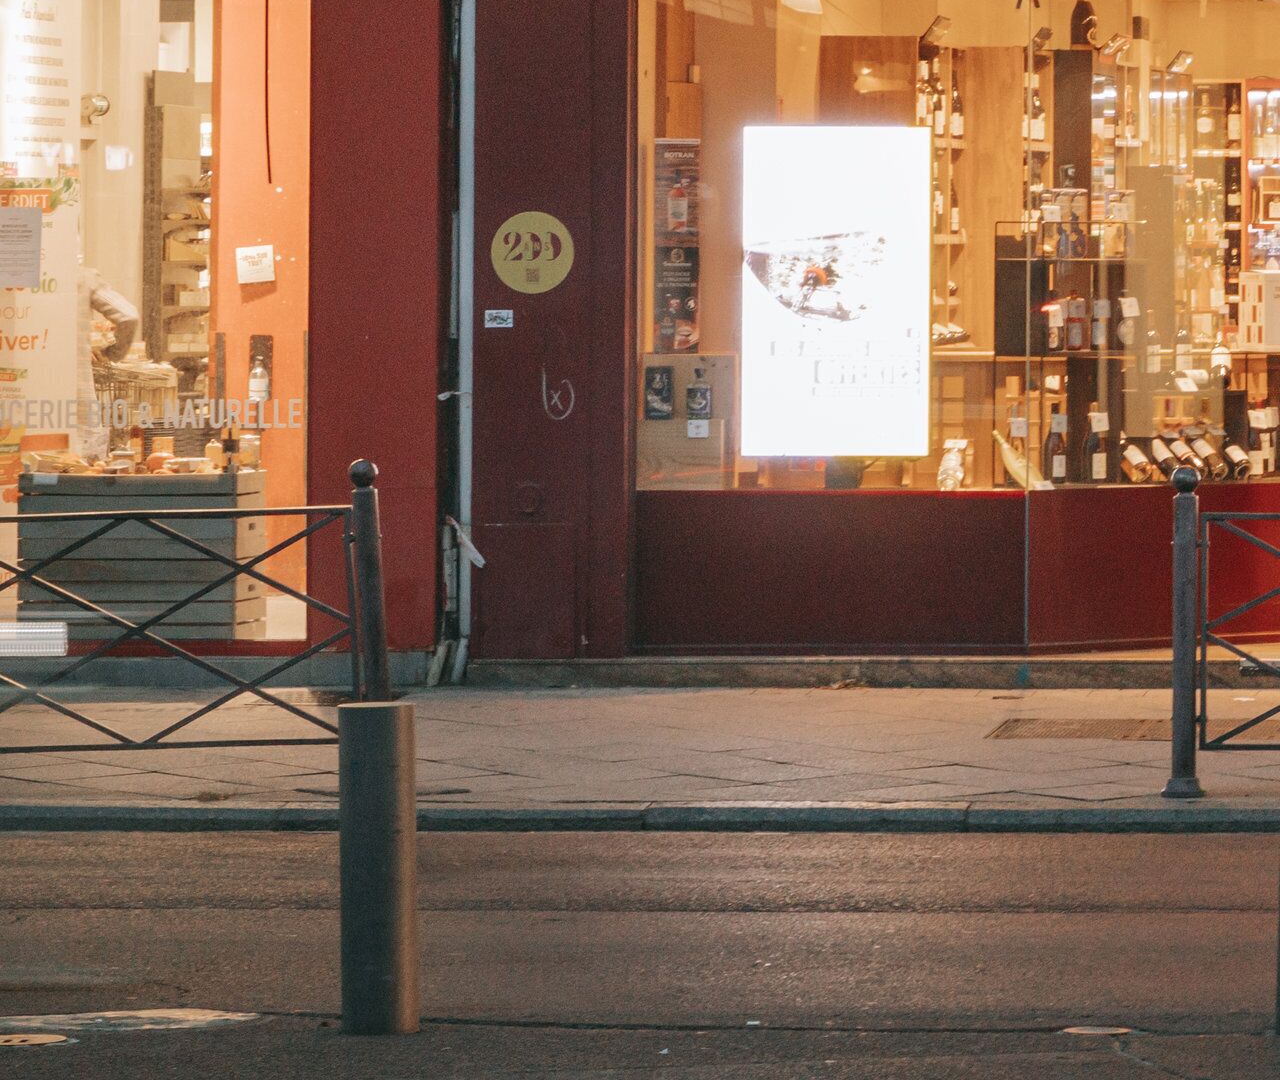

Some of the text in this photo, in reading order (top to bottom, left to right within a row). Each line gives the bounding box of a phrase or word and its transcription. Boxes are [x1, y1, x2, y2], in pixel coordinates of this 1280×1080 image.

[0, 305, 32, 320] our
[86, 398, 127, 428] BIO
[138, 400, 154, 428] &
[163, 398, 303, 429] NATURELLE
